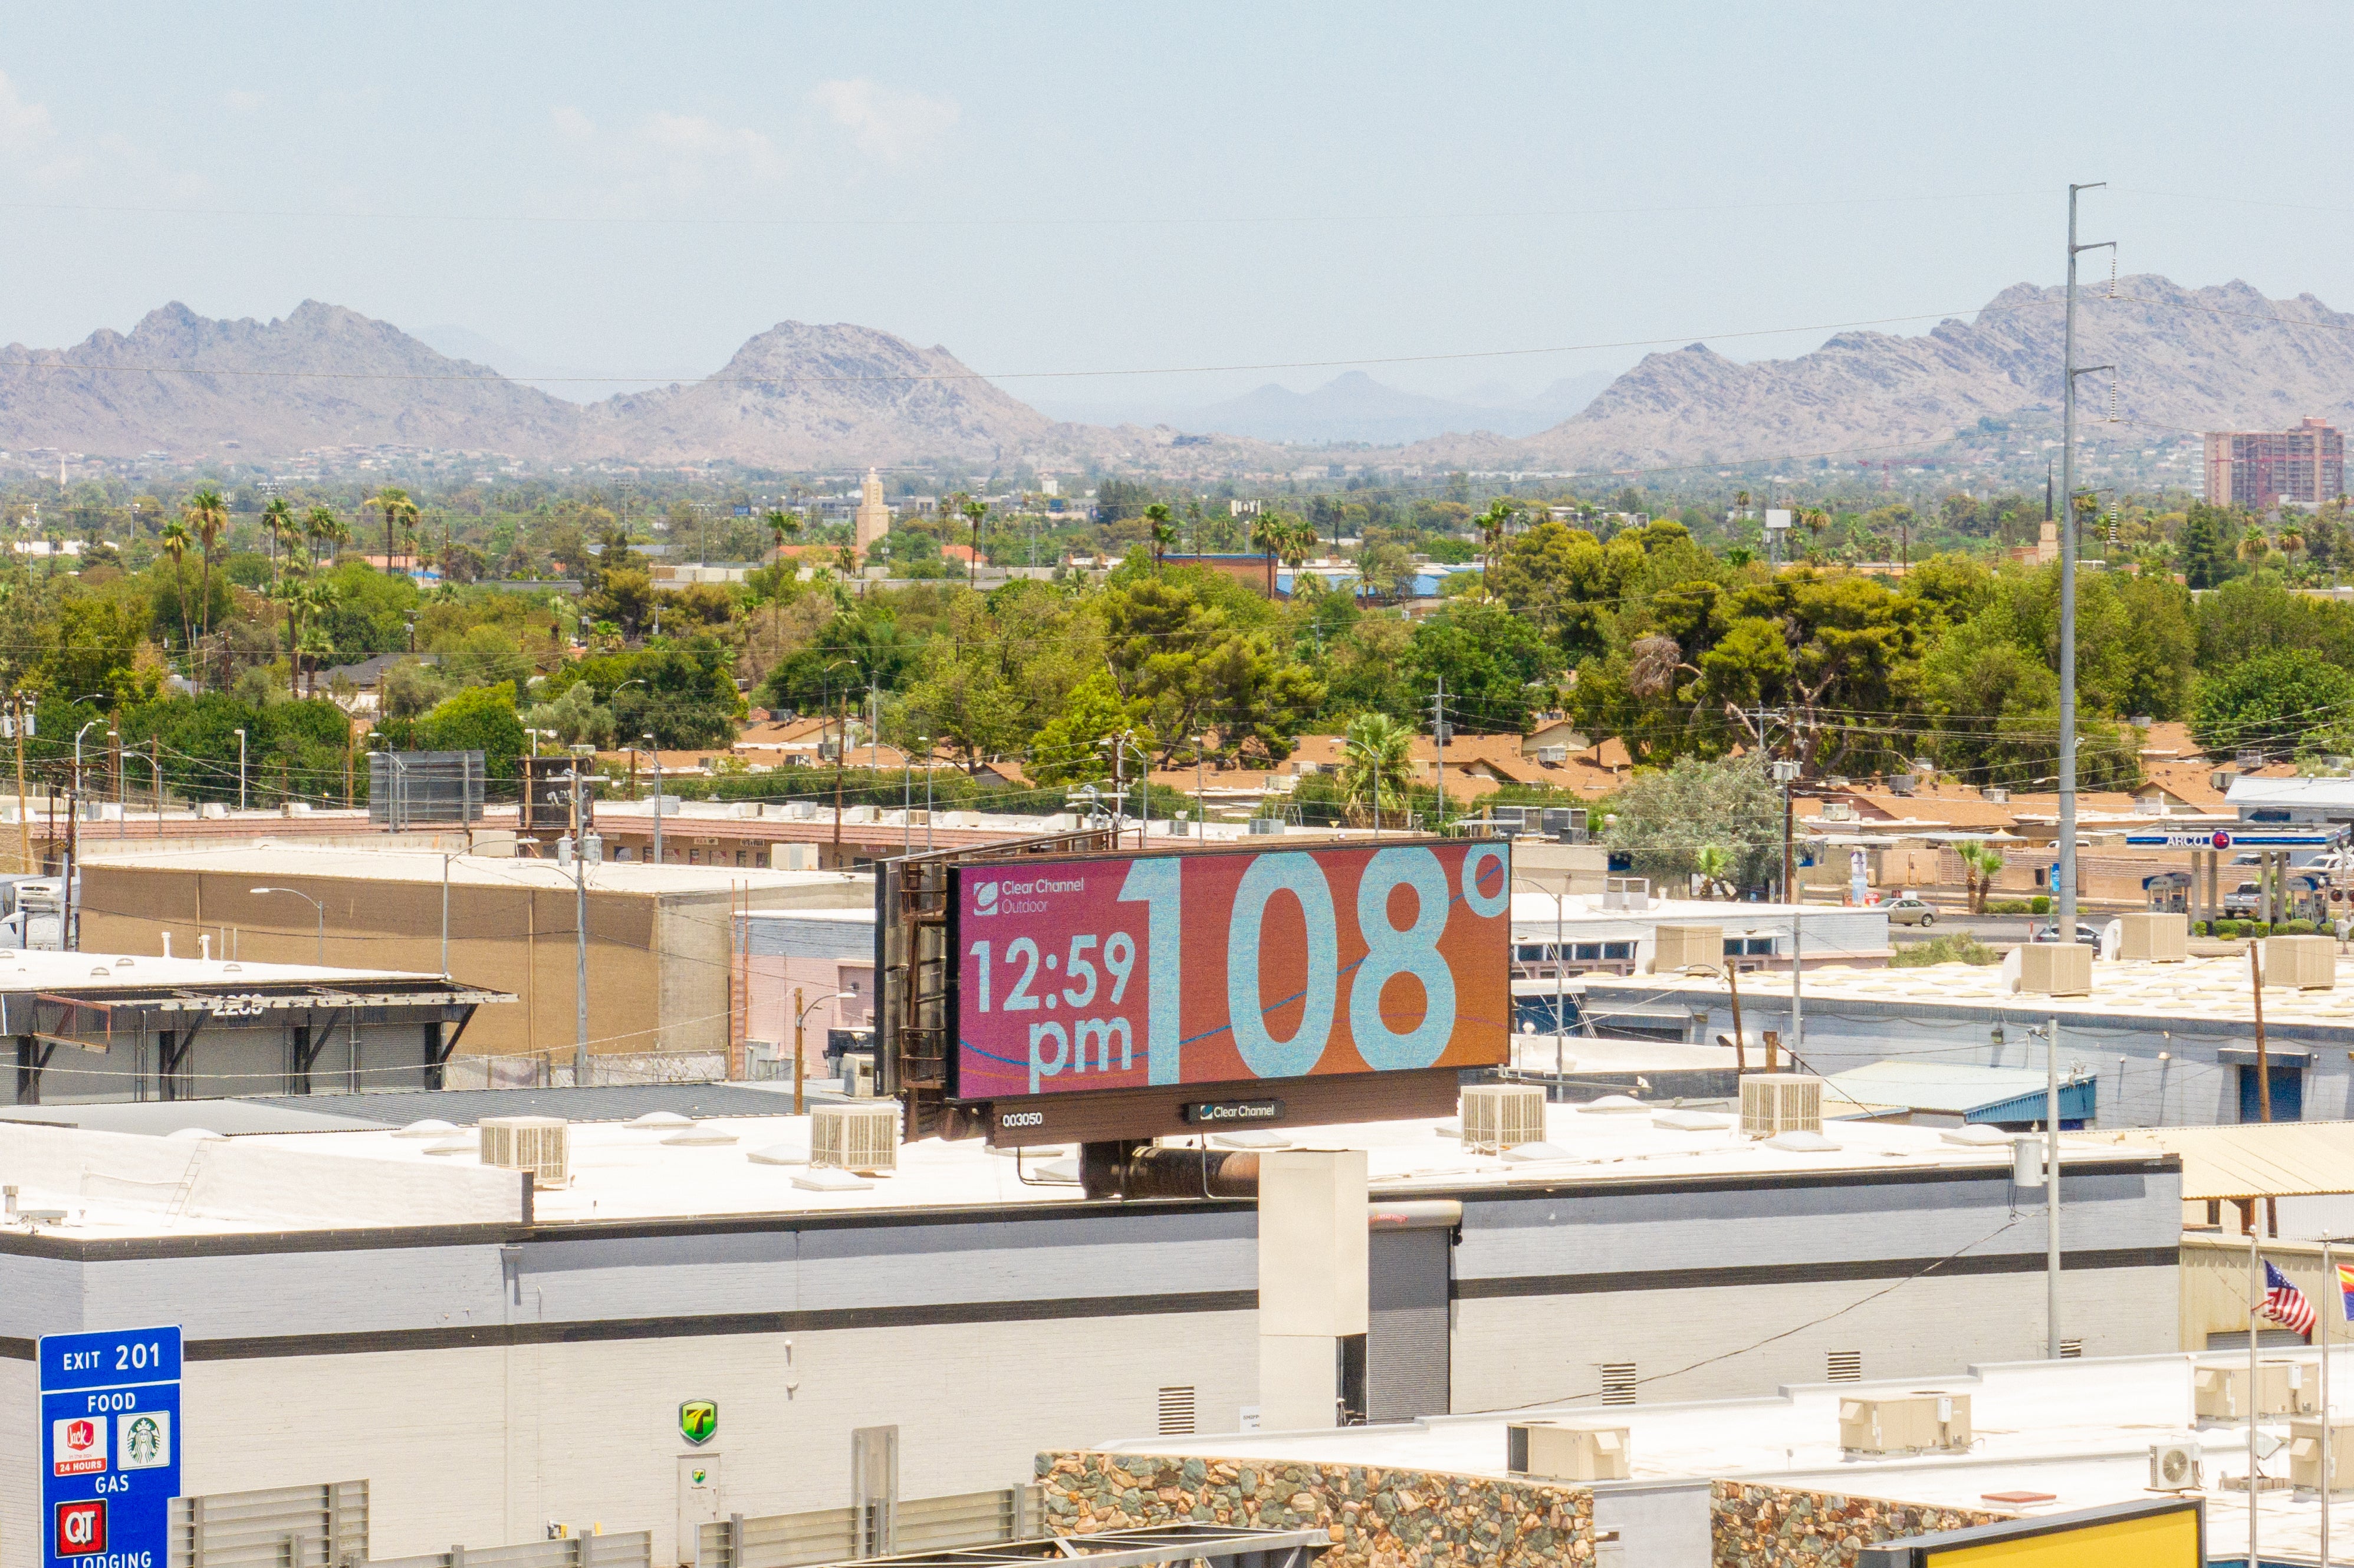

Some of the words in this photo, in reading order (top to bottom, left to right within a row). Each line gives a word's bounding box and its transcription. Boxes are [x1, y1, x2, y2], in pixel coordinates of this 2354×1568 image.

[2166, 836, 2203, 847] ARCO
[1002, 880, 1033, 895] Clear
[1035, 877, 1084, 893] Channel
[1002, 899, 1048, 914] Outdoor
[969, 931, 1136, 1013] 12:59
[1029, 1016, 1132, 1094] pm
[1002, 1112, 1043, 1127] 003050
[1214, 1106, 1238, 1118] Clear
[1238, 1104, 1274, 1117] Channel
[63, 1351, 101, 1370] EXIT
[116, 1342, 159, 1370] 201
[88, 1392, 136, 1412] FOOD
[67, 1422, 93, 1447] Jack
[60, 1464, 70, 1472] 24
[73, 1460, 102, 1471] HOURS
[95, 1474, 129, 1494] GAS
[65, 1511, 96, 1544] QT
